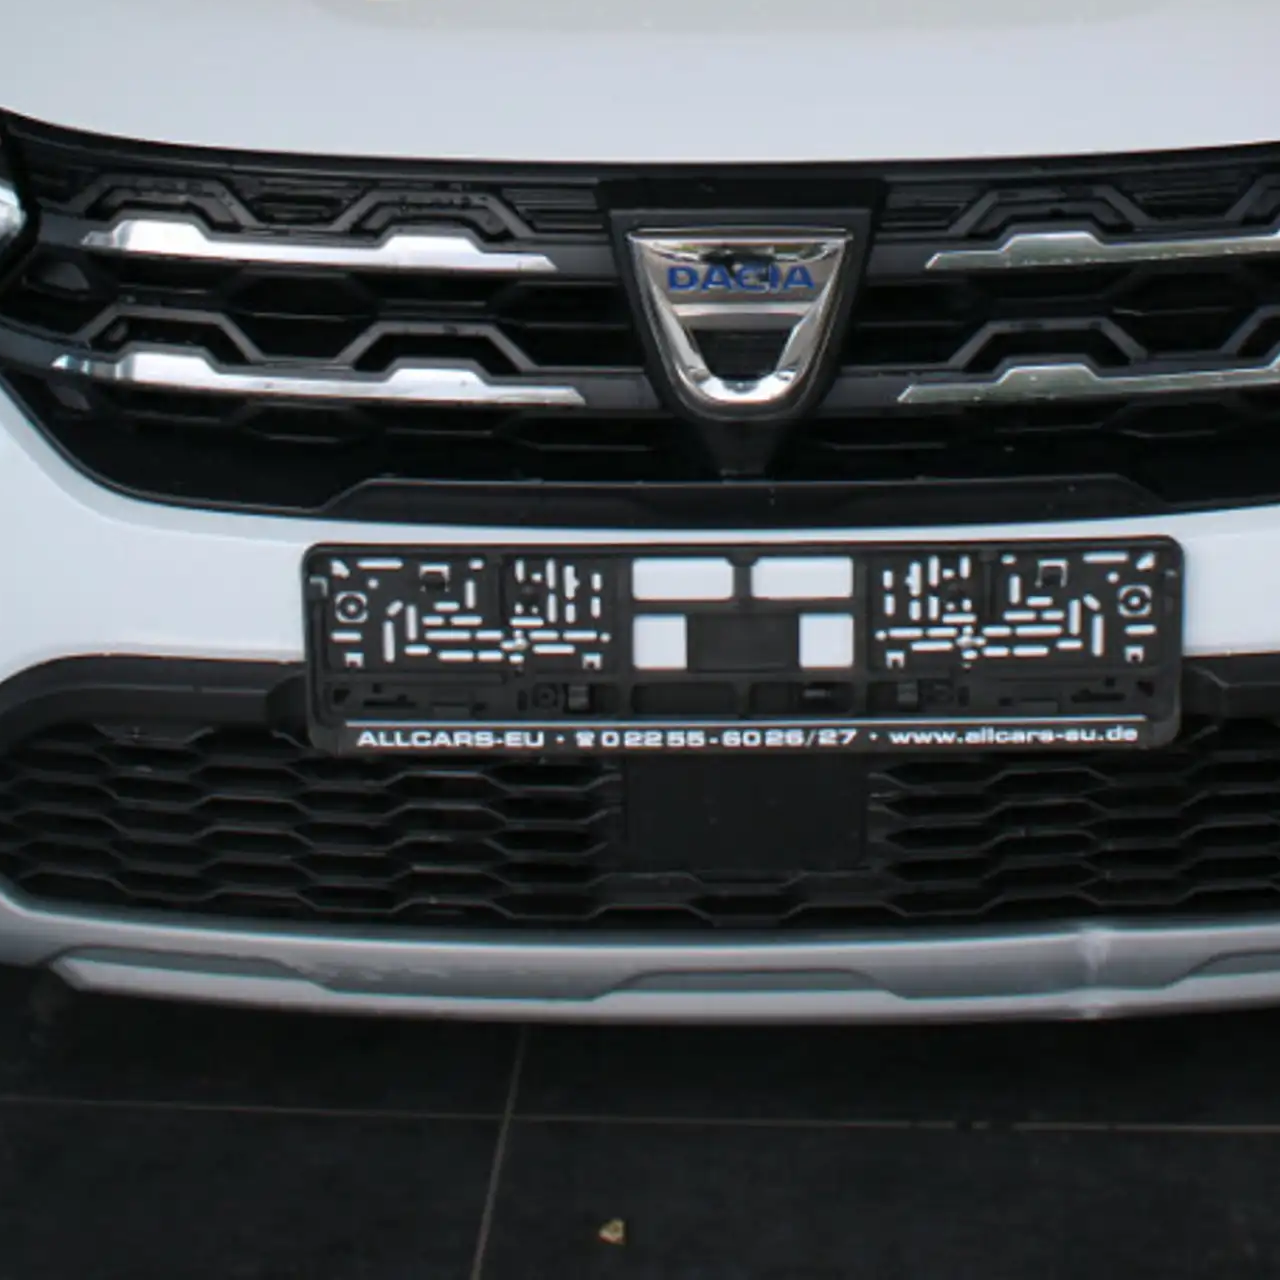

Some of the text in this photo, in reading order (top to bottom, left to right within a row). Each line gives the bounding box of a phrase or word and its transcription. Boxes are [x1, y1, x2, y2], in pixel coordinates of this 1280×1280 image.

[666, 263, 816, 292] DACIA
[357, 730, 545, 748] ALLCARS-EU
[888, 724, 1139, 745] www.allcars-eu.de
